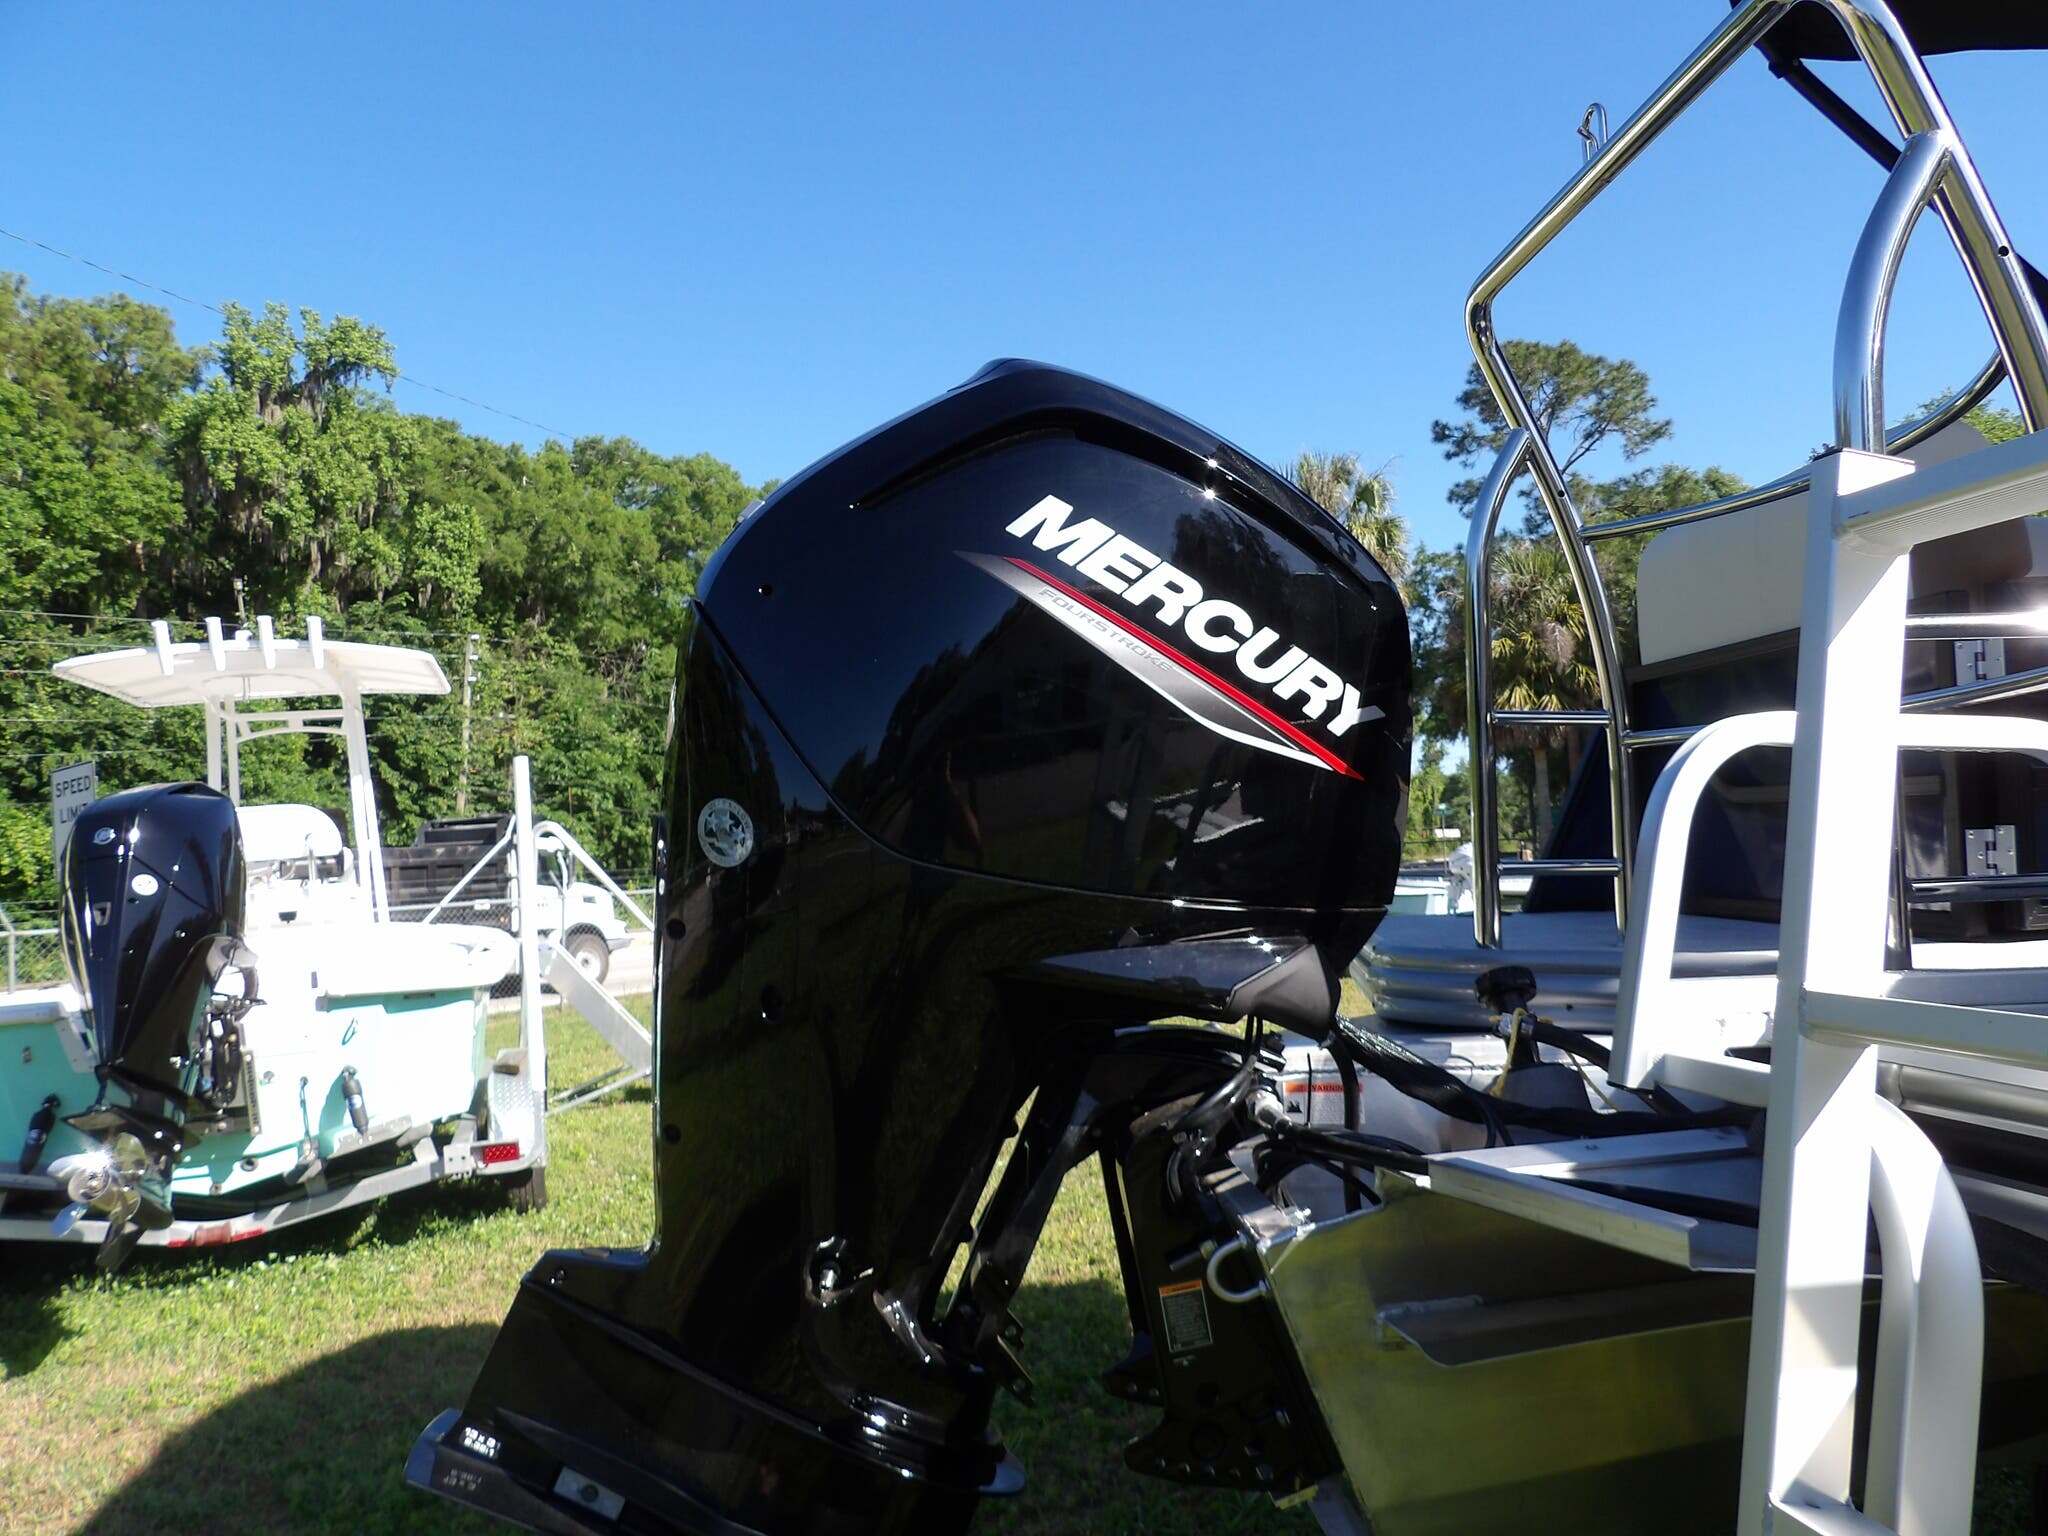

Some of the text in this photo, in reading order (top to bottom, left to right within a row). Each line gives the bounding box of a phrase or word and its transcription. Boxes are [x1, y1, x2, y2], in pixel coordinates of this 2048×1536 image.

[1006, 495, 1386, 736] MERCURY
[1039, 586, 1173, 672] FOURSTROKE
[56, 776, 91, 797] SPEED
